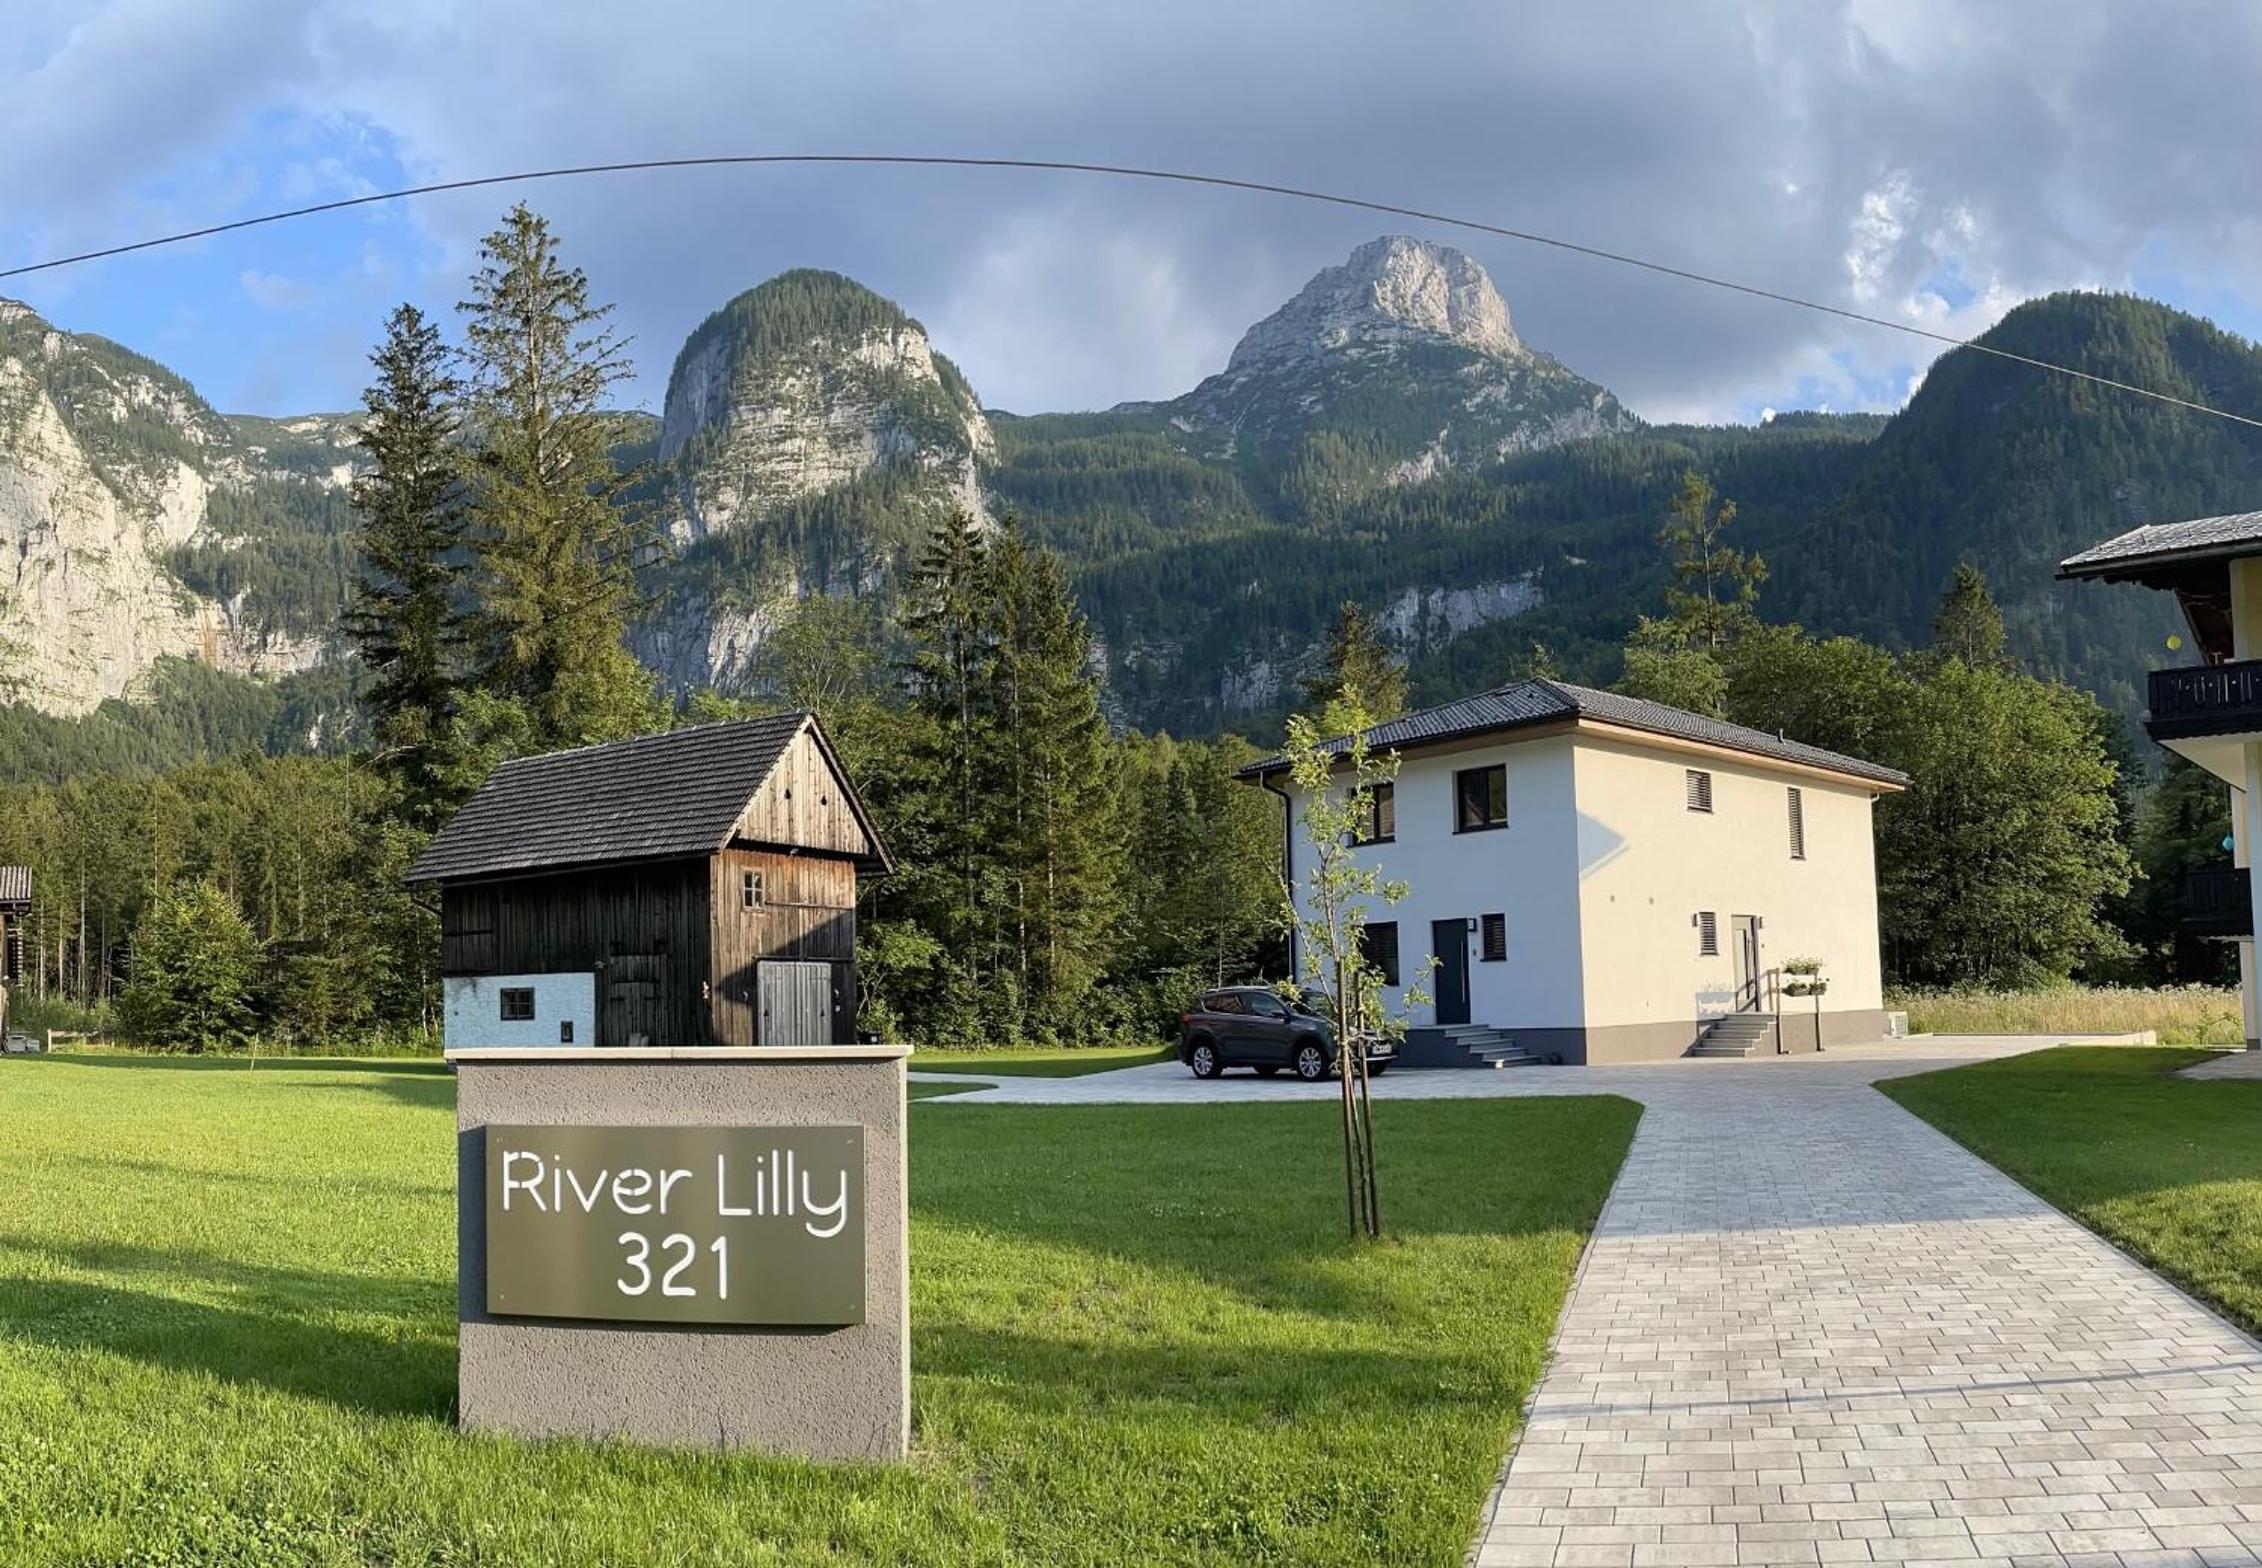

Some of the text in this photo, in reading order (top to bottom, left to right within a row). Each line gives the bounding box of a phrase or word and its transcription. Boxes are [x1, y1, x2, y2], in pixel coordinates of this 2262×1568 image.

[503, 1149, 847, 1238] River Lilly
[617, 1231, 727, 1299] 321
